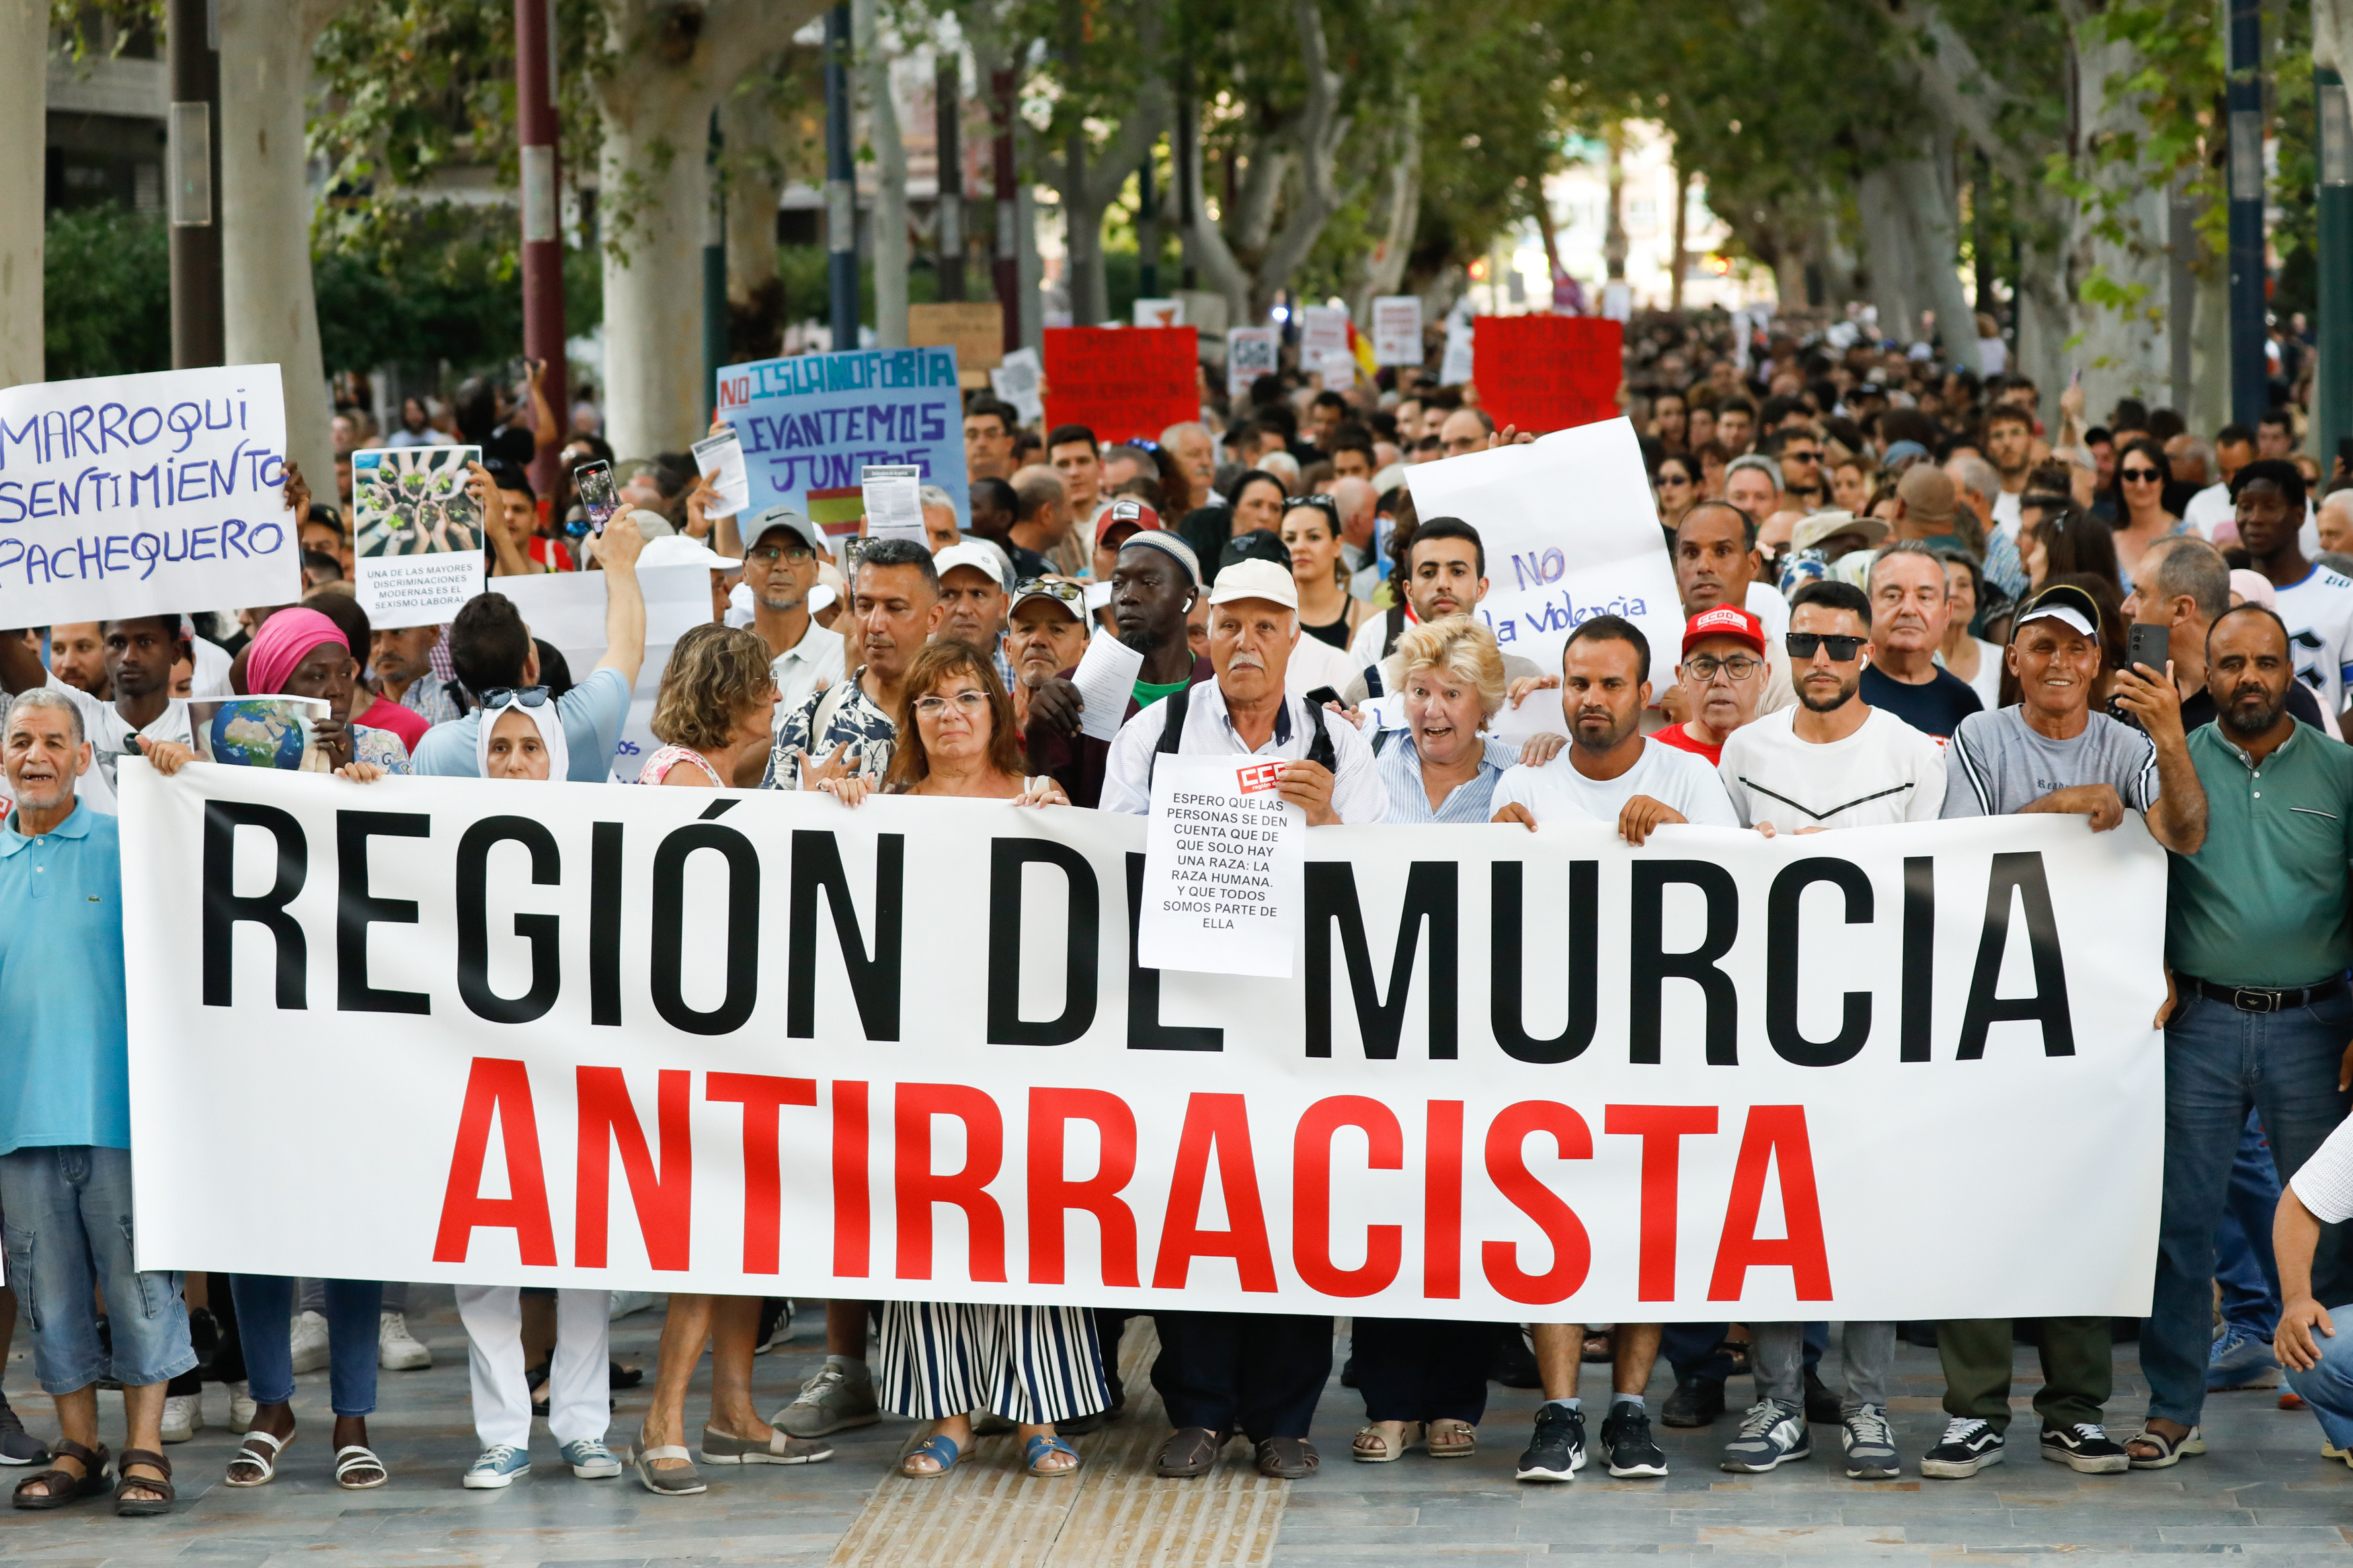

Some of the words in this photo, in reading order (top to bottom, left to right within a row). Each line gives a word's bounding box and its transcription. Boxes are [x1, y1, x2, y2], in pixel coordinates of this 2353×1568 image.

[720, 376, 750, 408] NO
[367, 570, 388, 578] UNA
[391, 569, 403, 577] DE
[406, 567, 424, 575] LAS
[426, 563, 473, 574] MAYORES
[1511, 547, 1565, 591] NO
[374, 575, 467, 588] DISCRIMINACIONES
[379, 587, 434, 598] MODERNAS
[437, 586, 448, 594] ES
[375, 599, 418, 609] SEXISMO
[421, 596, 466, 606] LABORAL
[1701, 612, 1733, 623] CCOO
[1252, 782, 1271, 790] región
[1173, 792, 1225, 807] ESPERO
[1229, 797, 1256, 809] QUE
[1259, 800, 1284, 811] LAS
[1167, 808, 1238, 823] PERSONAS
[1242, 814, 1258, 825] SE
[1262, 815, 1287, 827] DEN
[1174, 824, 1226, 837] CUENTA
[1230, 829, 1258, 840] QUE
[1262, 831, 1279, 842] DE
[1176, 839, 1204, 851] QUE
[1208, 841, 1244, 854] SOLO
[1248, 845, 1274, 857] HAY
[1178, 855, 1205, 866] UNA
[1209, 857, 1249, 870] RAZA:
[1254, 861, 1270, 872] LA
[1172, 870, 1207, 882] RAZA
[1211, 872, 1273, 888] HUMANA.
[1177, 886, 1185, 896] Y
[1189, 886, 1216, 897] QUE
[1220, 889, 1265, 901] TODOS
[1163, 901, 1211, 913] SOMOS
[1215, 903, 1257, 915] PARTE
[1261, 906, 1277, 917] DE
[202, 798, 905, 1042] REGIÓN
[1304, 851, 2077, 1067] MURCIA
[1203, 918, 1234, 930] ELLA
[432, 1057, 1834, 1305] ANTIRRACISTA
